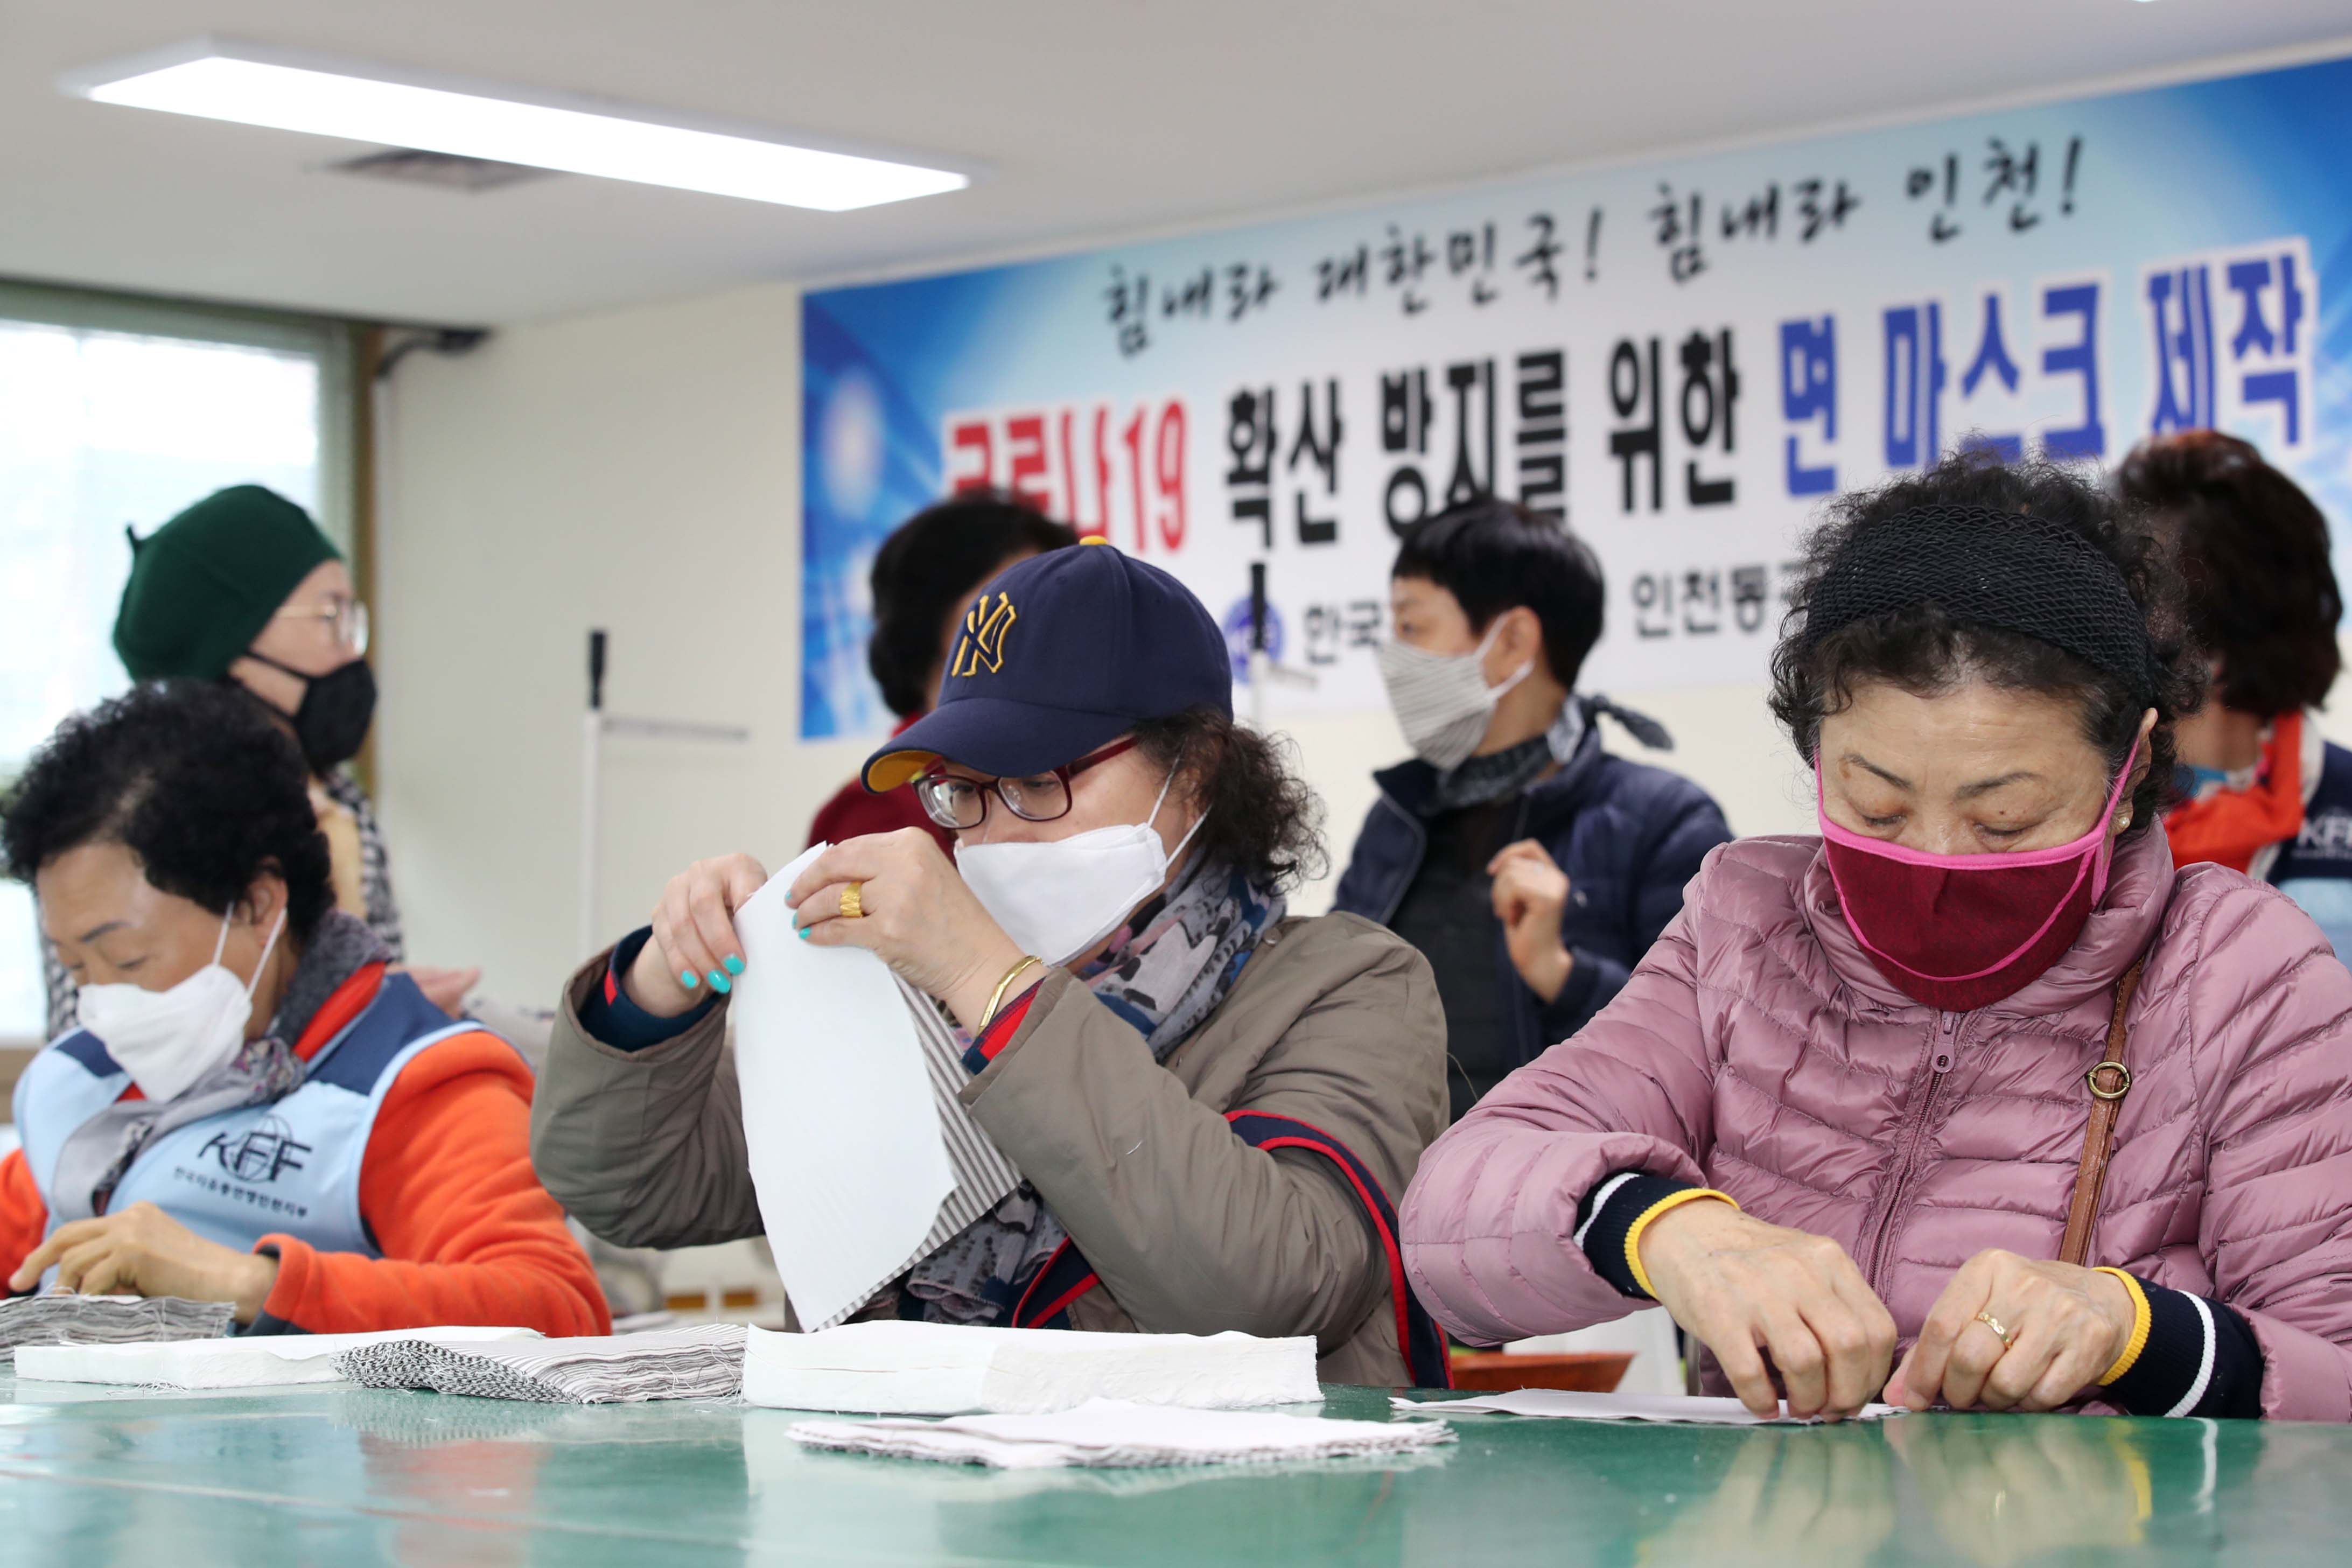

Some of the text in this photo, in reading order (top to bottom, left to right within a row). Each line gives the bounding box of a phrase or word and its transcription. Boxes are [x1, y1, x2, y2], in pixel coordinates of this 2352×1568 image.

[1102, 136, 2082, 358] 힘내라 대한민국! 힘내라 인천!
[1225, 377, 1343, 550] 확산
[1381, 348, 1566, 538] 방지를
[1608, 325, 1741, 513] 위한
[1779, 312, 1838, 499] 면
[1882, 282, 2104, 467] 마스크
[2147, 253, 2306, 447] 제작
[198, 1132, 312, 1181] KFF
